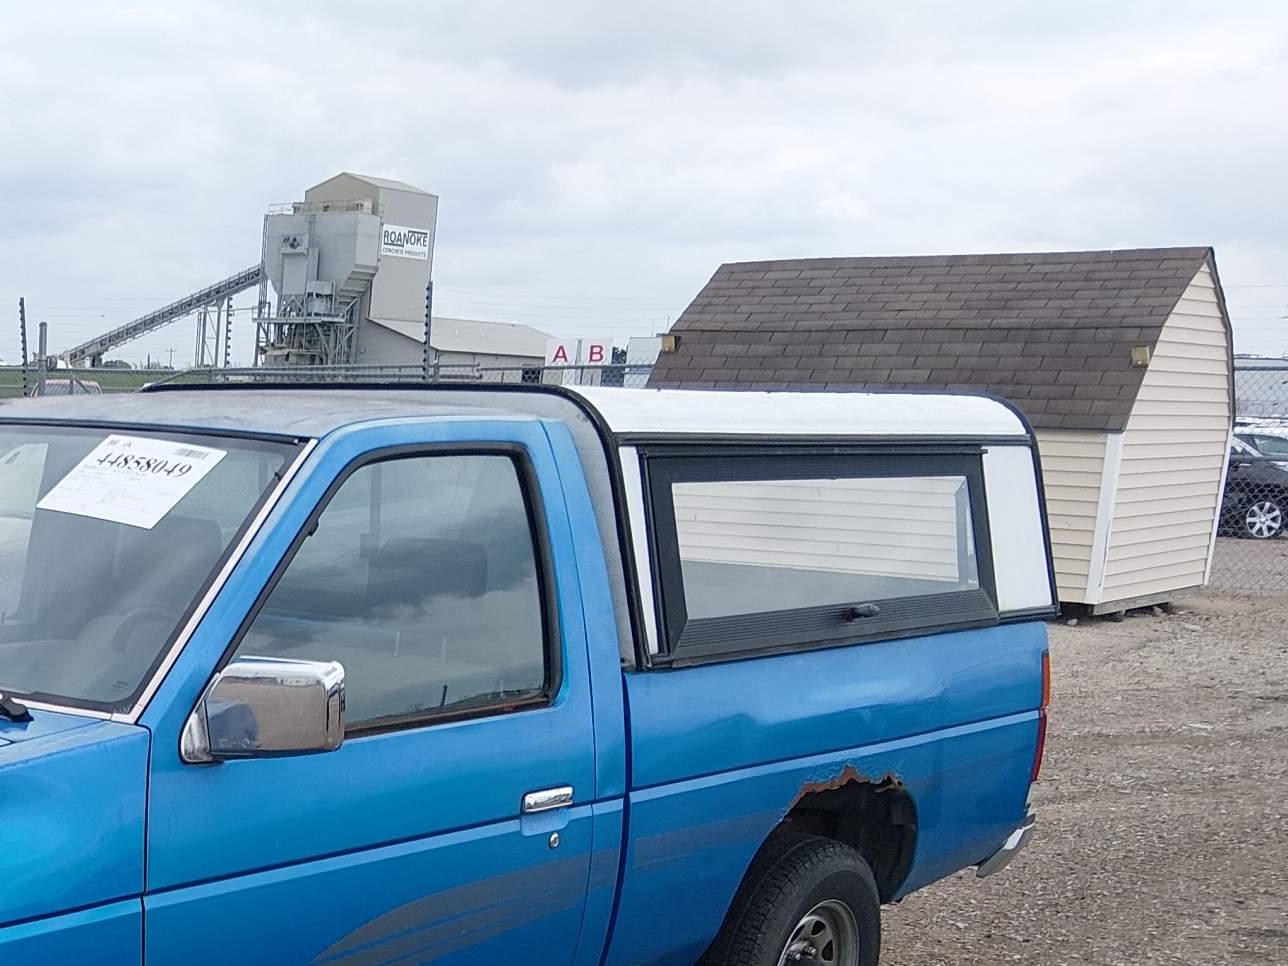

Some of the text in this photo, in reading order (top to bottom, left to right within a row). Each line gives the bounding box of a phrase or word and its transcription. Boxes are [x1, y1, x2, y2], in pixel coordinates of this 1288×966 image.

[383, 230, 428, 247] ROANOKE
[552, 345, 569, 363] A
[589, 345, 604, 363] B
[97, 452, 193, 478] 44858049
